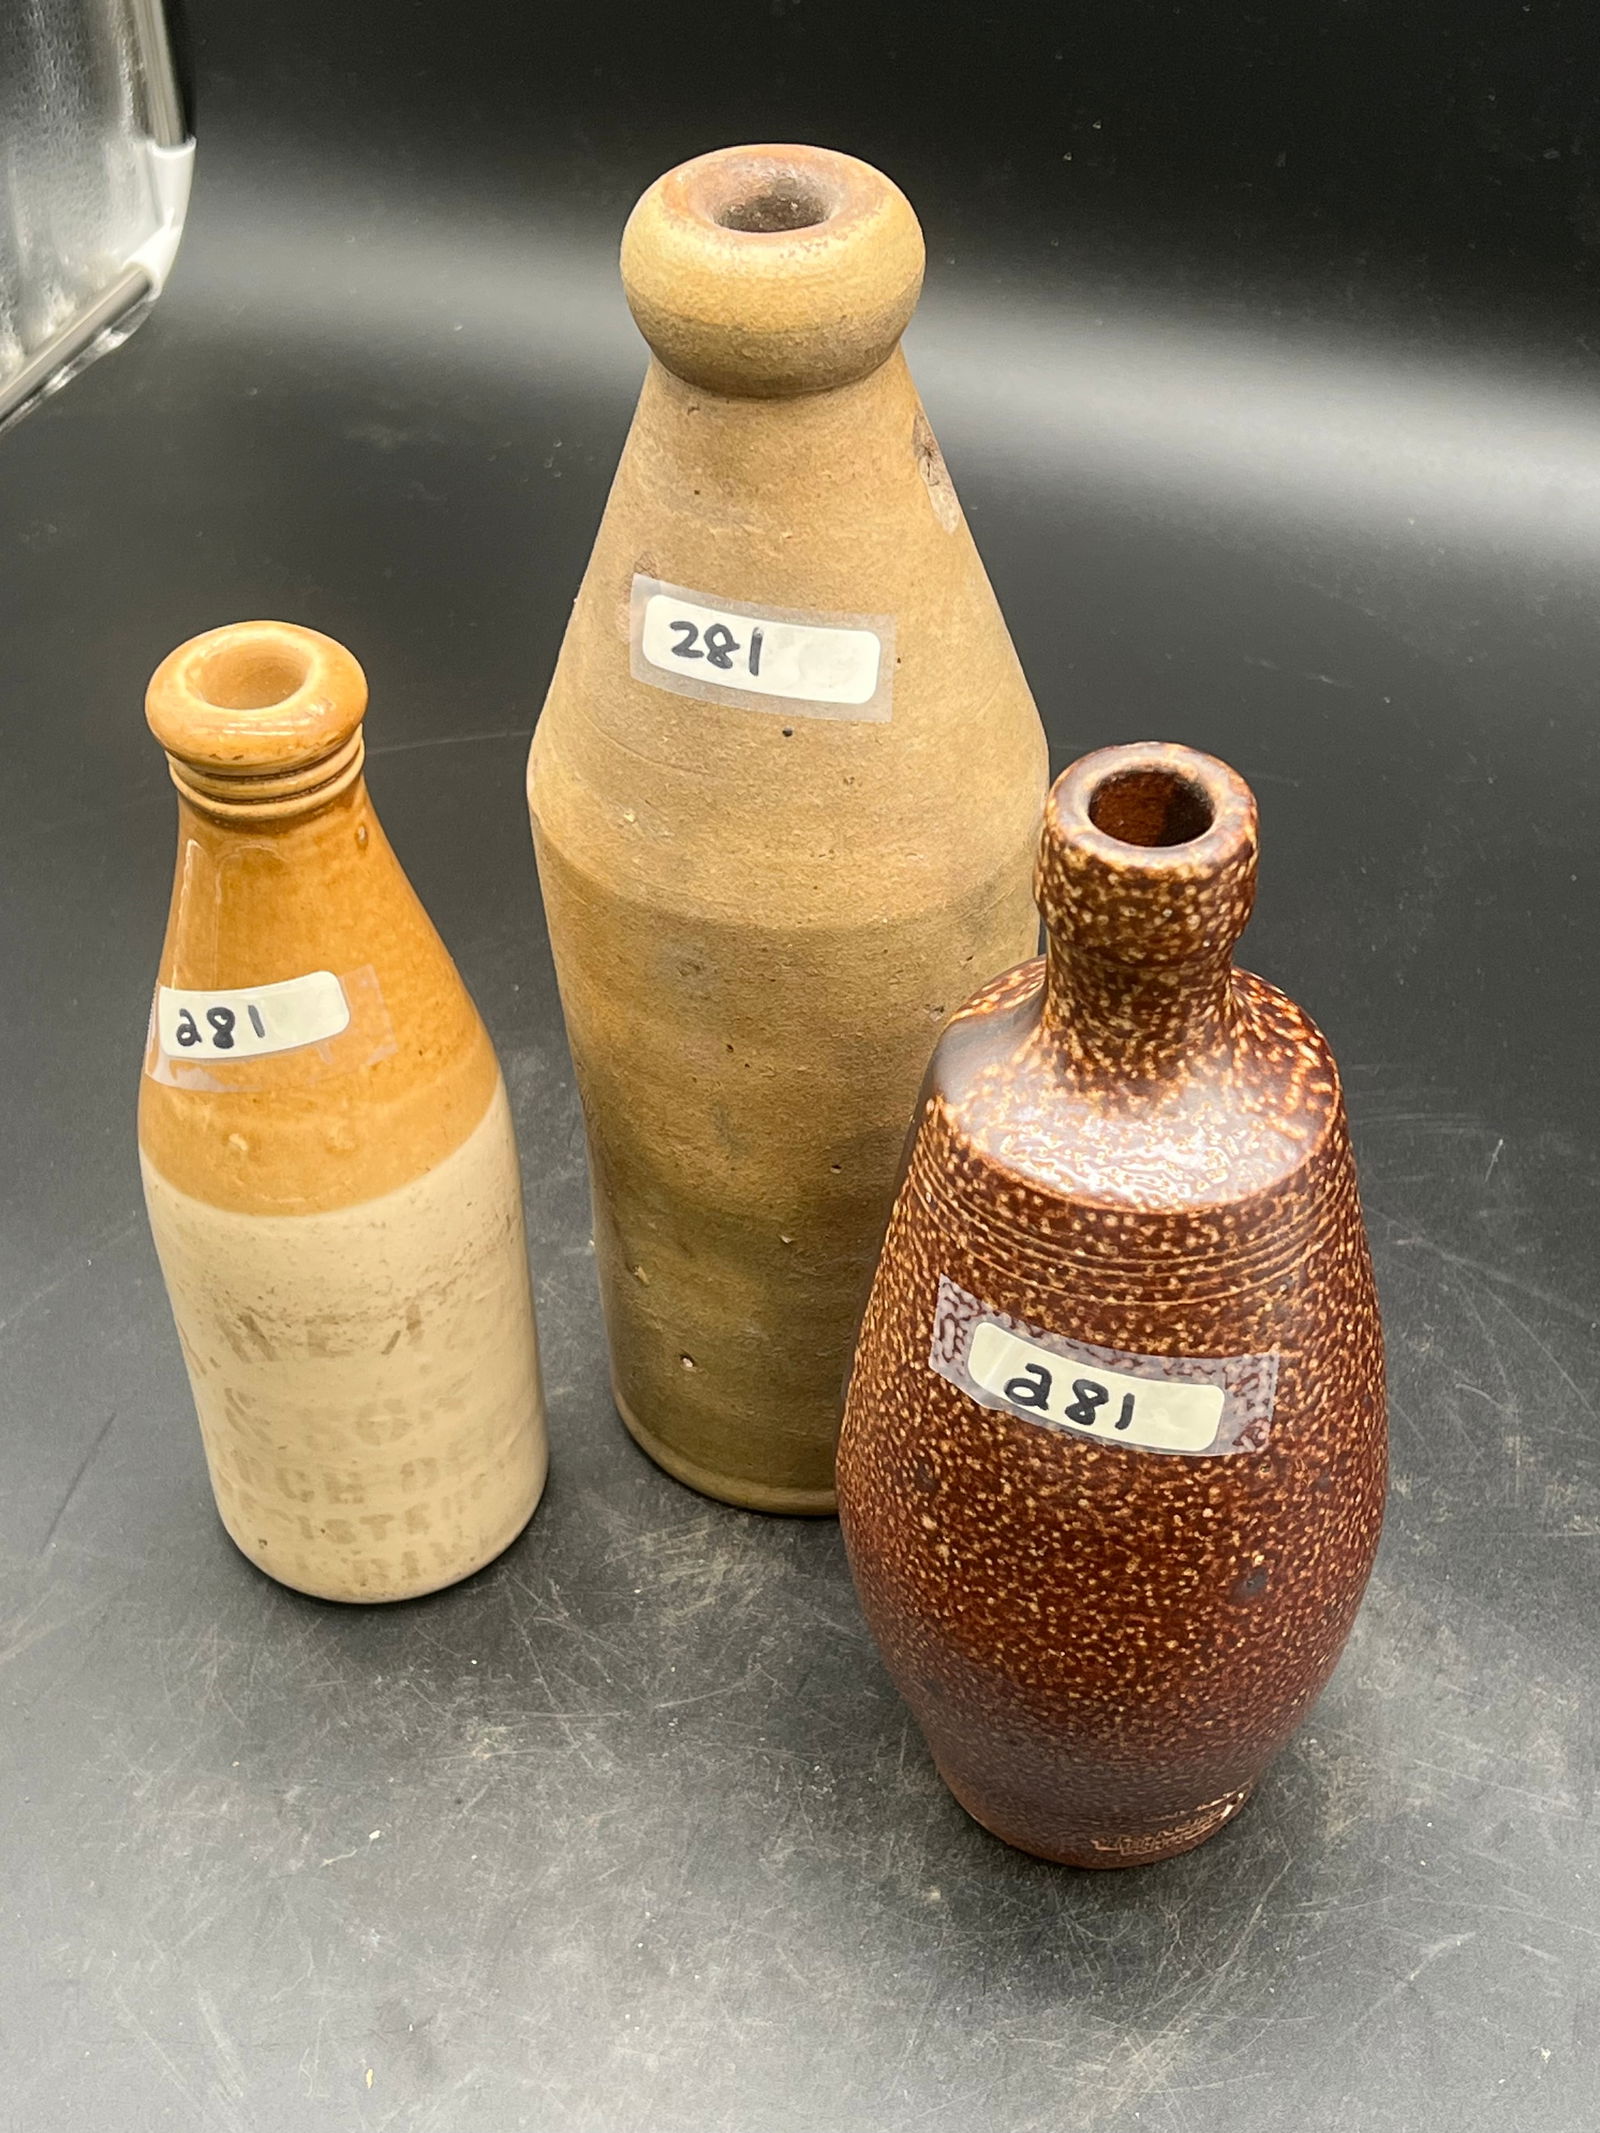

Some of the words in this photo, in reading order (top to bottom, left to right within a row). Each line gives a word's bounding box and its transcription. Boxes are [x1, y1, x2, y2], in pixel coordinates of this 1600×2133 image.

[669, 620, 765, 677] 281
[176, 1001, 265, 1050] 281
[1003, 1363, 1135, 1430] 281
